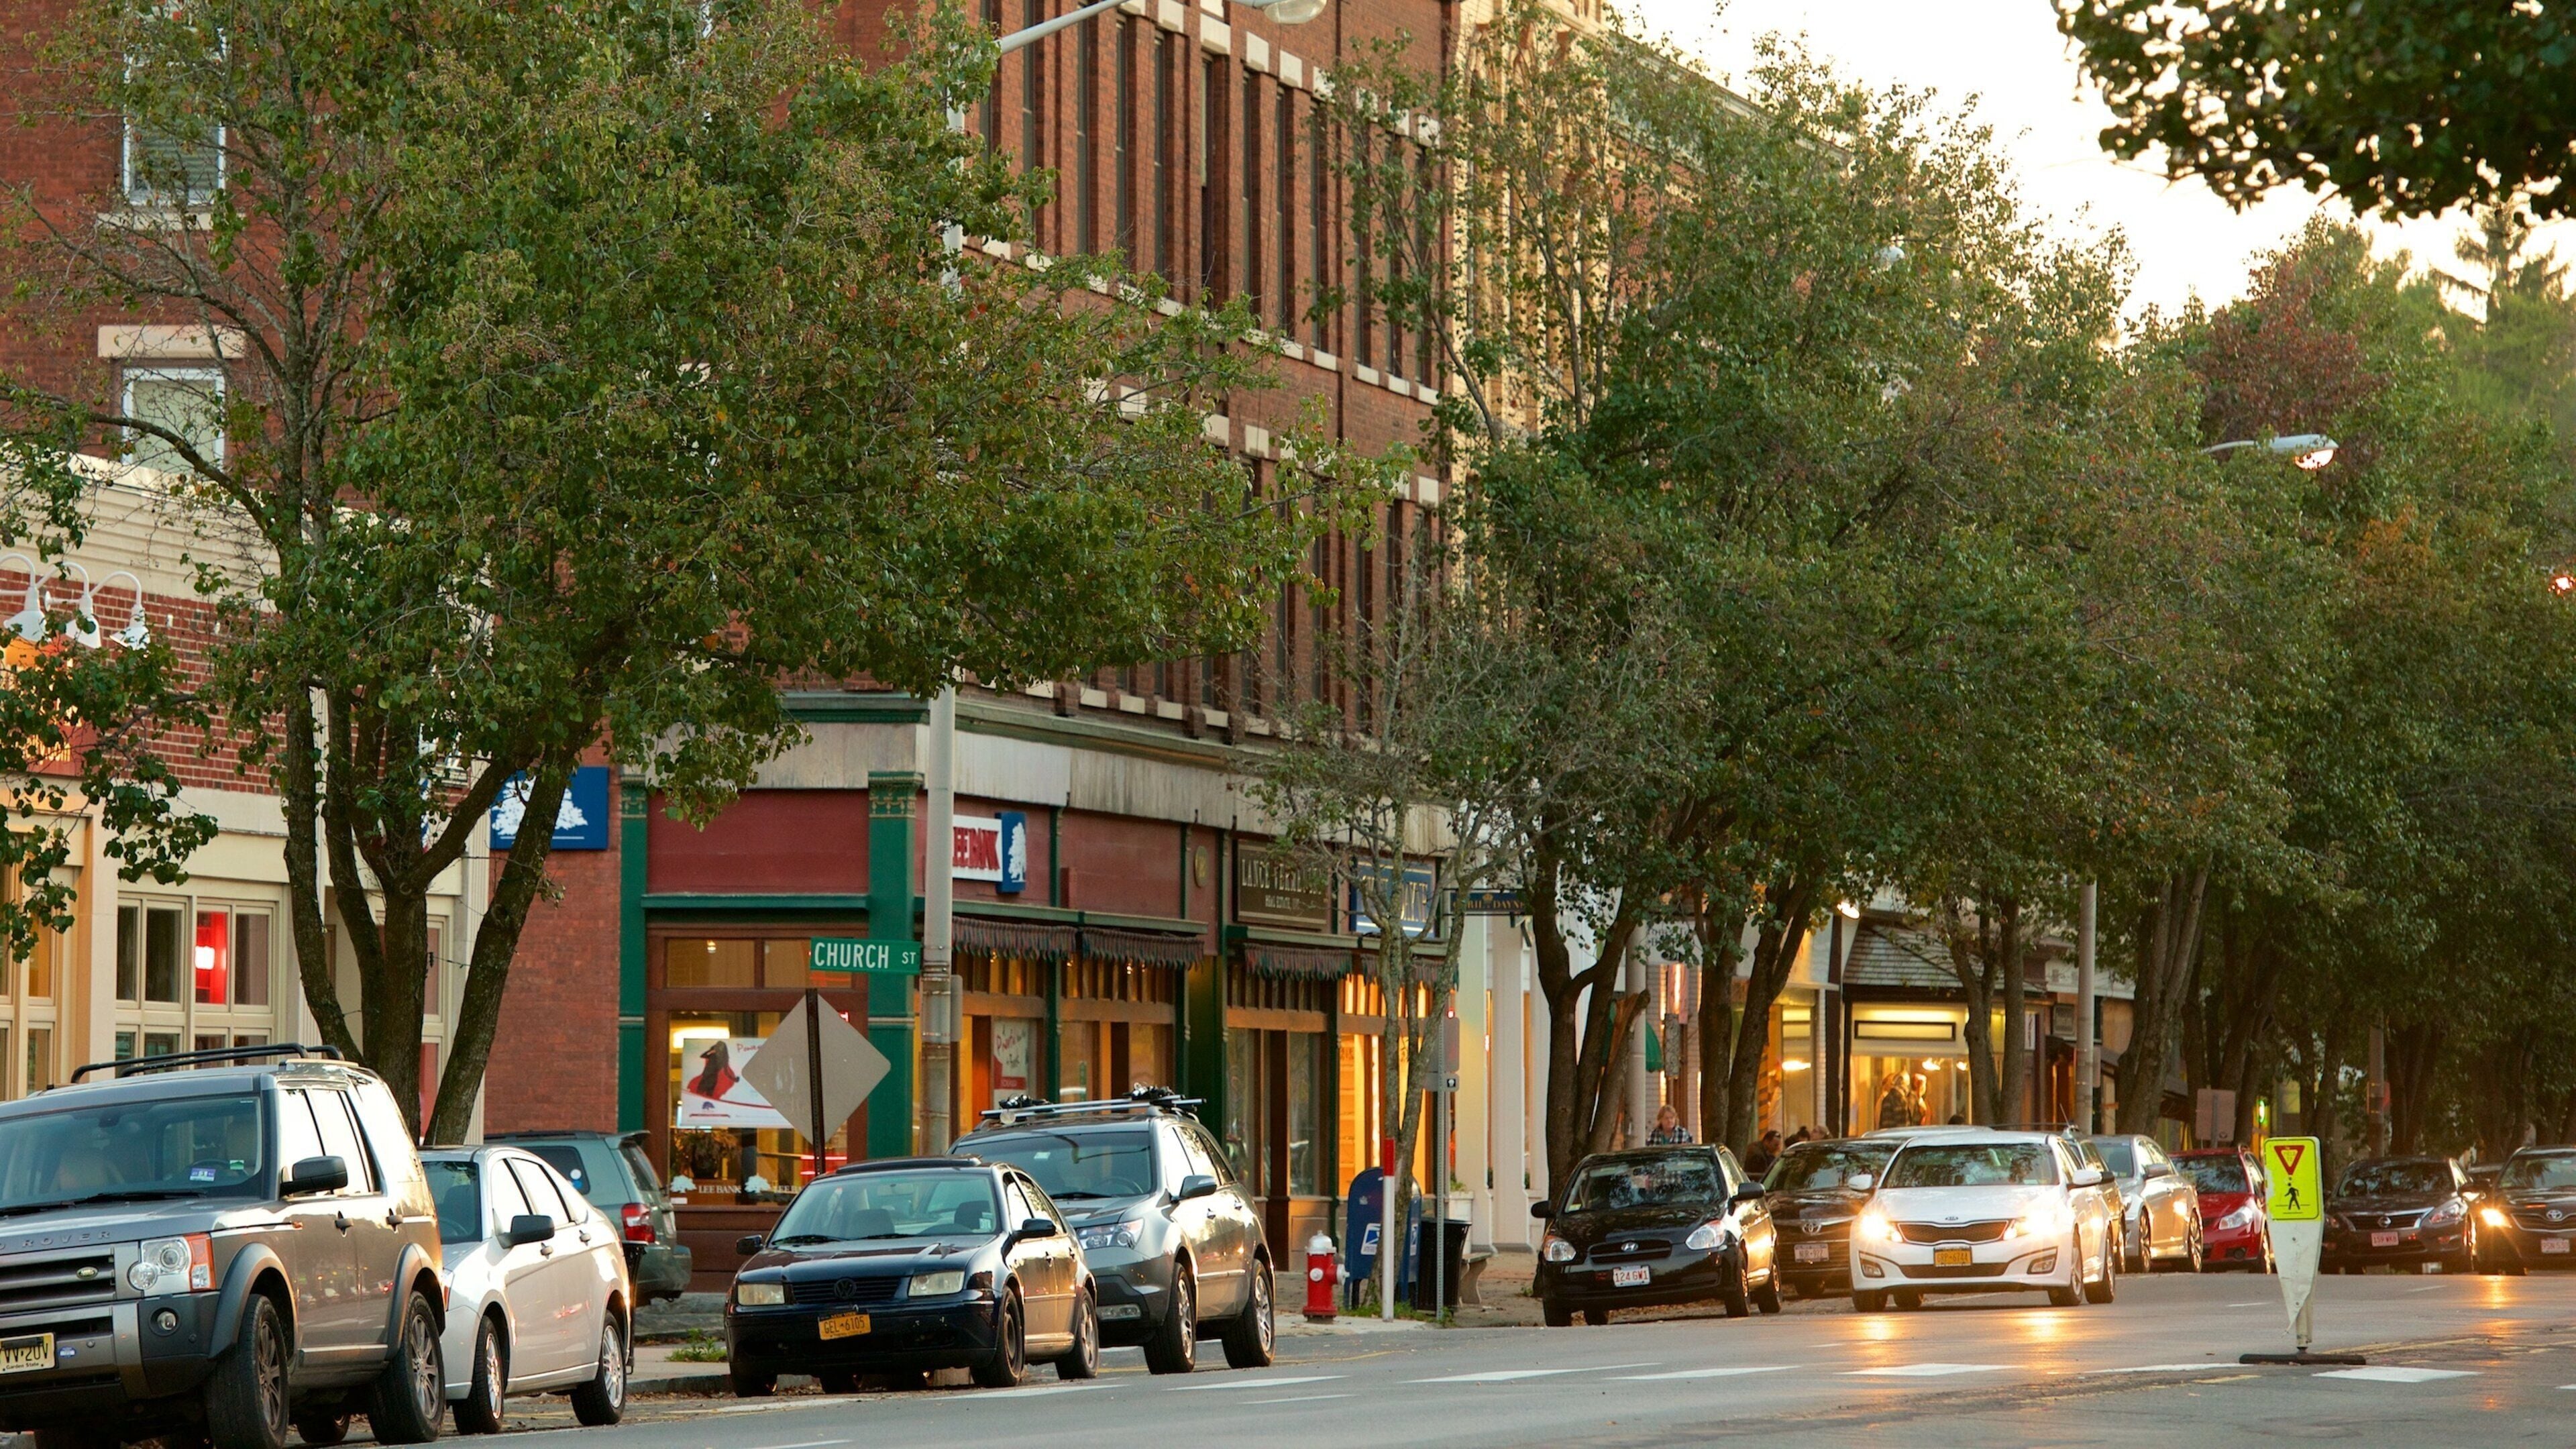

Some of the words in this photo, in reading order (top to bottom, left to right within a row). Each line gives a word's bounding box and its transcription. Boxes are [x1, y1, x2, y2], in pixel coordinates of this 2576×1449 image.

[814, 942, 890, 969] CHURCH
[902, 951, 916, 965] ST
[698, 1185, 715, 1193] LEE
[716, 1185, 741, 1193] BANK
[22, 1232, 111, 1248] ROVER
[1615, 1271, 1631, 1282] 124
